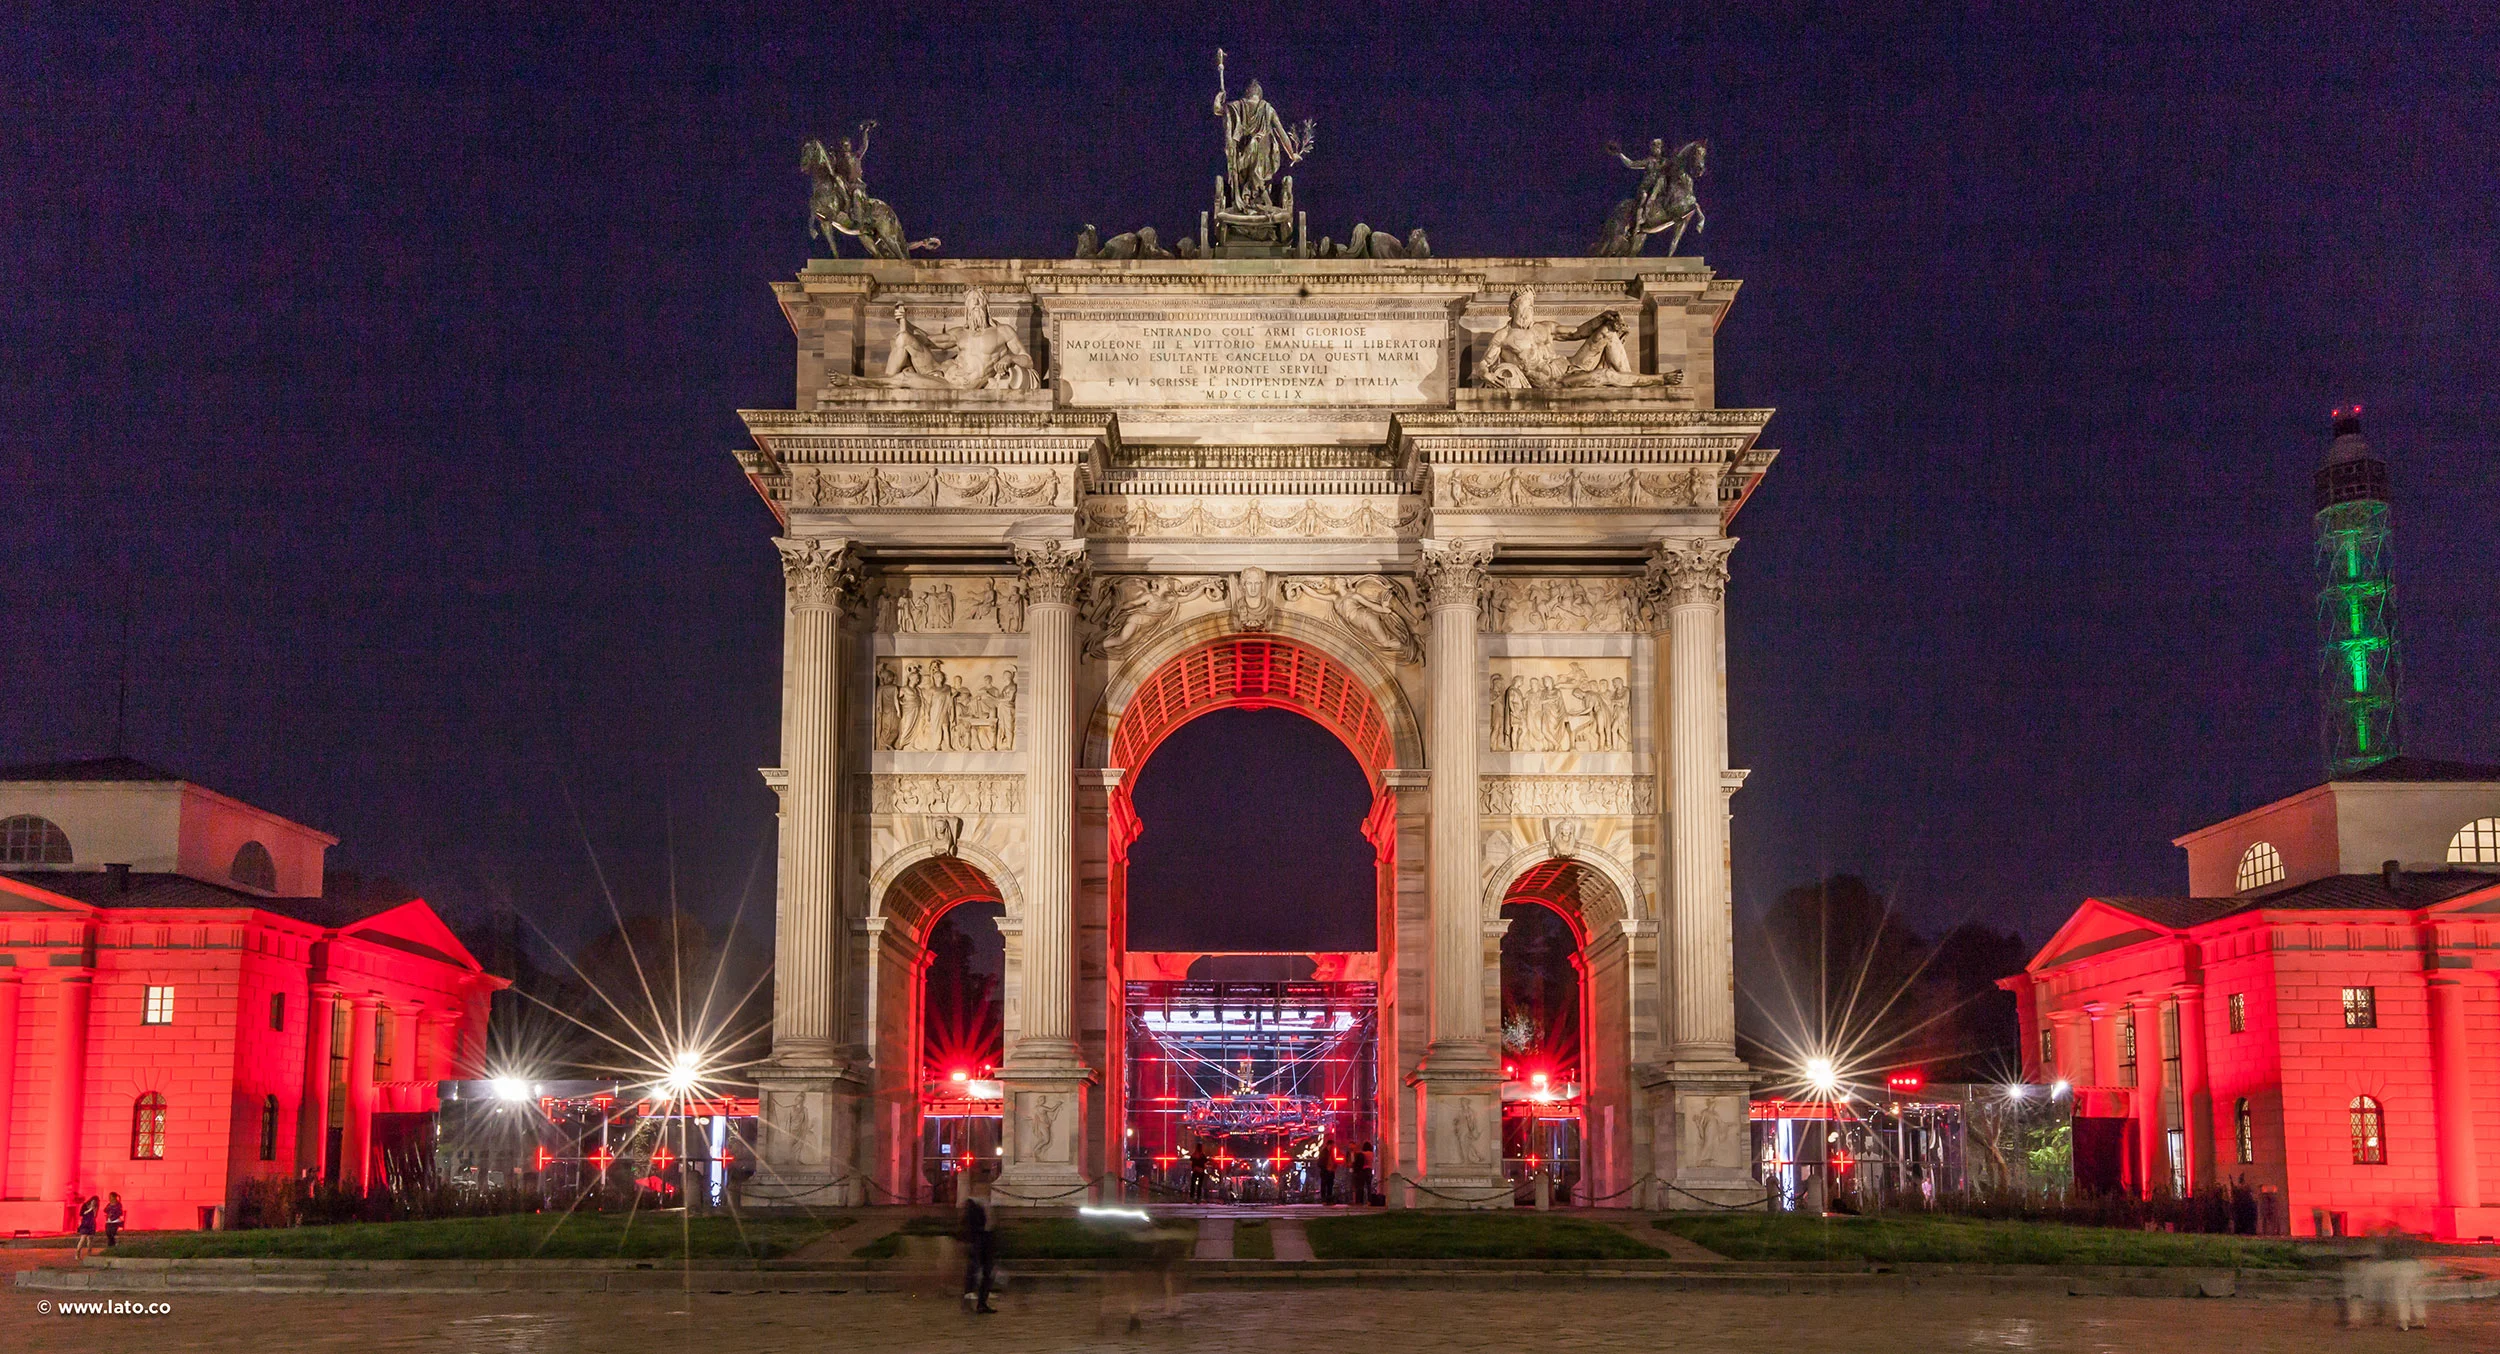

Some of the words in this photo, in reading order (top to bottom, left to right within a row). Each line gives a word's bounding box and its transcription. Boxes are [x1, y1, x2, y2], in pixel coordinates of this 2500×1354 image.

[1143, 327, 1212, 337] ENTRANDO
[1264, 327, 1295, 337] ARMI
[1306, 327, 1367, 337] GLORIOSE
[1066, 340, 1142, 350] NAPOLEONE
[1152, 340, 1165, 350] III
[1176, 340, 1183, 350] E
[1193, 340, 1255, 350] VITTORIO
[1265, 340, 1334, 350] EMANUELE
[1344, 340, 1353, 350] II
[1363, 339, 1442, 349] LIBERATORI
[1088, 352, 1140, 362] MILANO
[1150, 352, 1219, 362] ESULTANTE
[1299, 352, 1316, 362] DA
[1324, 352, 1369, 362] QUESTI
[1378, 352, 1419, 361] MARMI
[1179, 365, 1194, 374] LE
[1203, 365, 1270, 374] IMPRONTE
[1279, 365, 1328, 374] SERVILI
[1108, 377, 1115, 387] E
[1127, 377, 1139, 387] VI
[1150, 377, 1199, 387] SCRISSE
[1225, 377, 1325, 387] INDIPENDENZA
[1355, 377, 1399, 387] ITALIA
